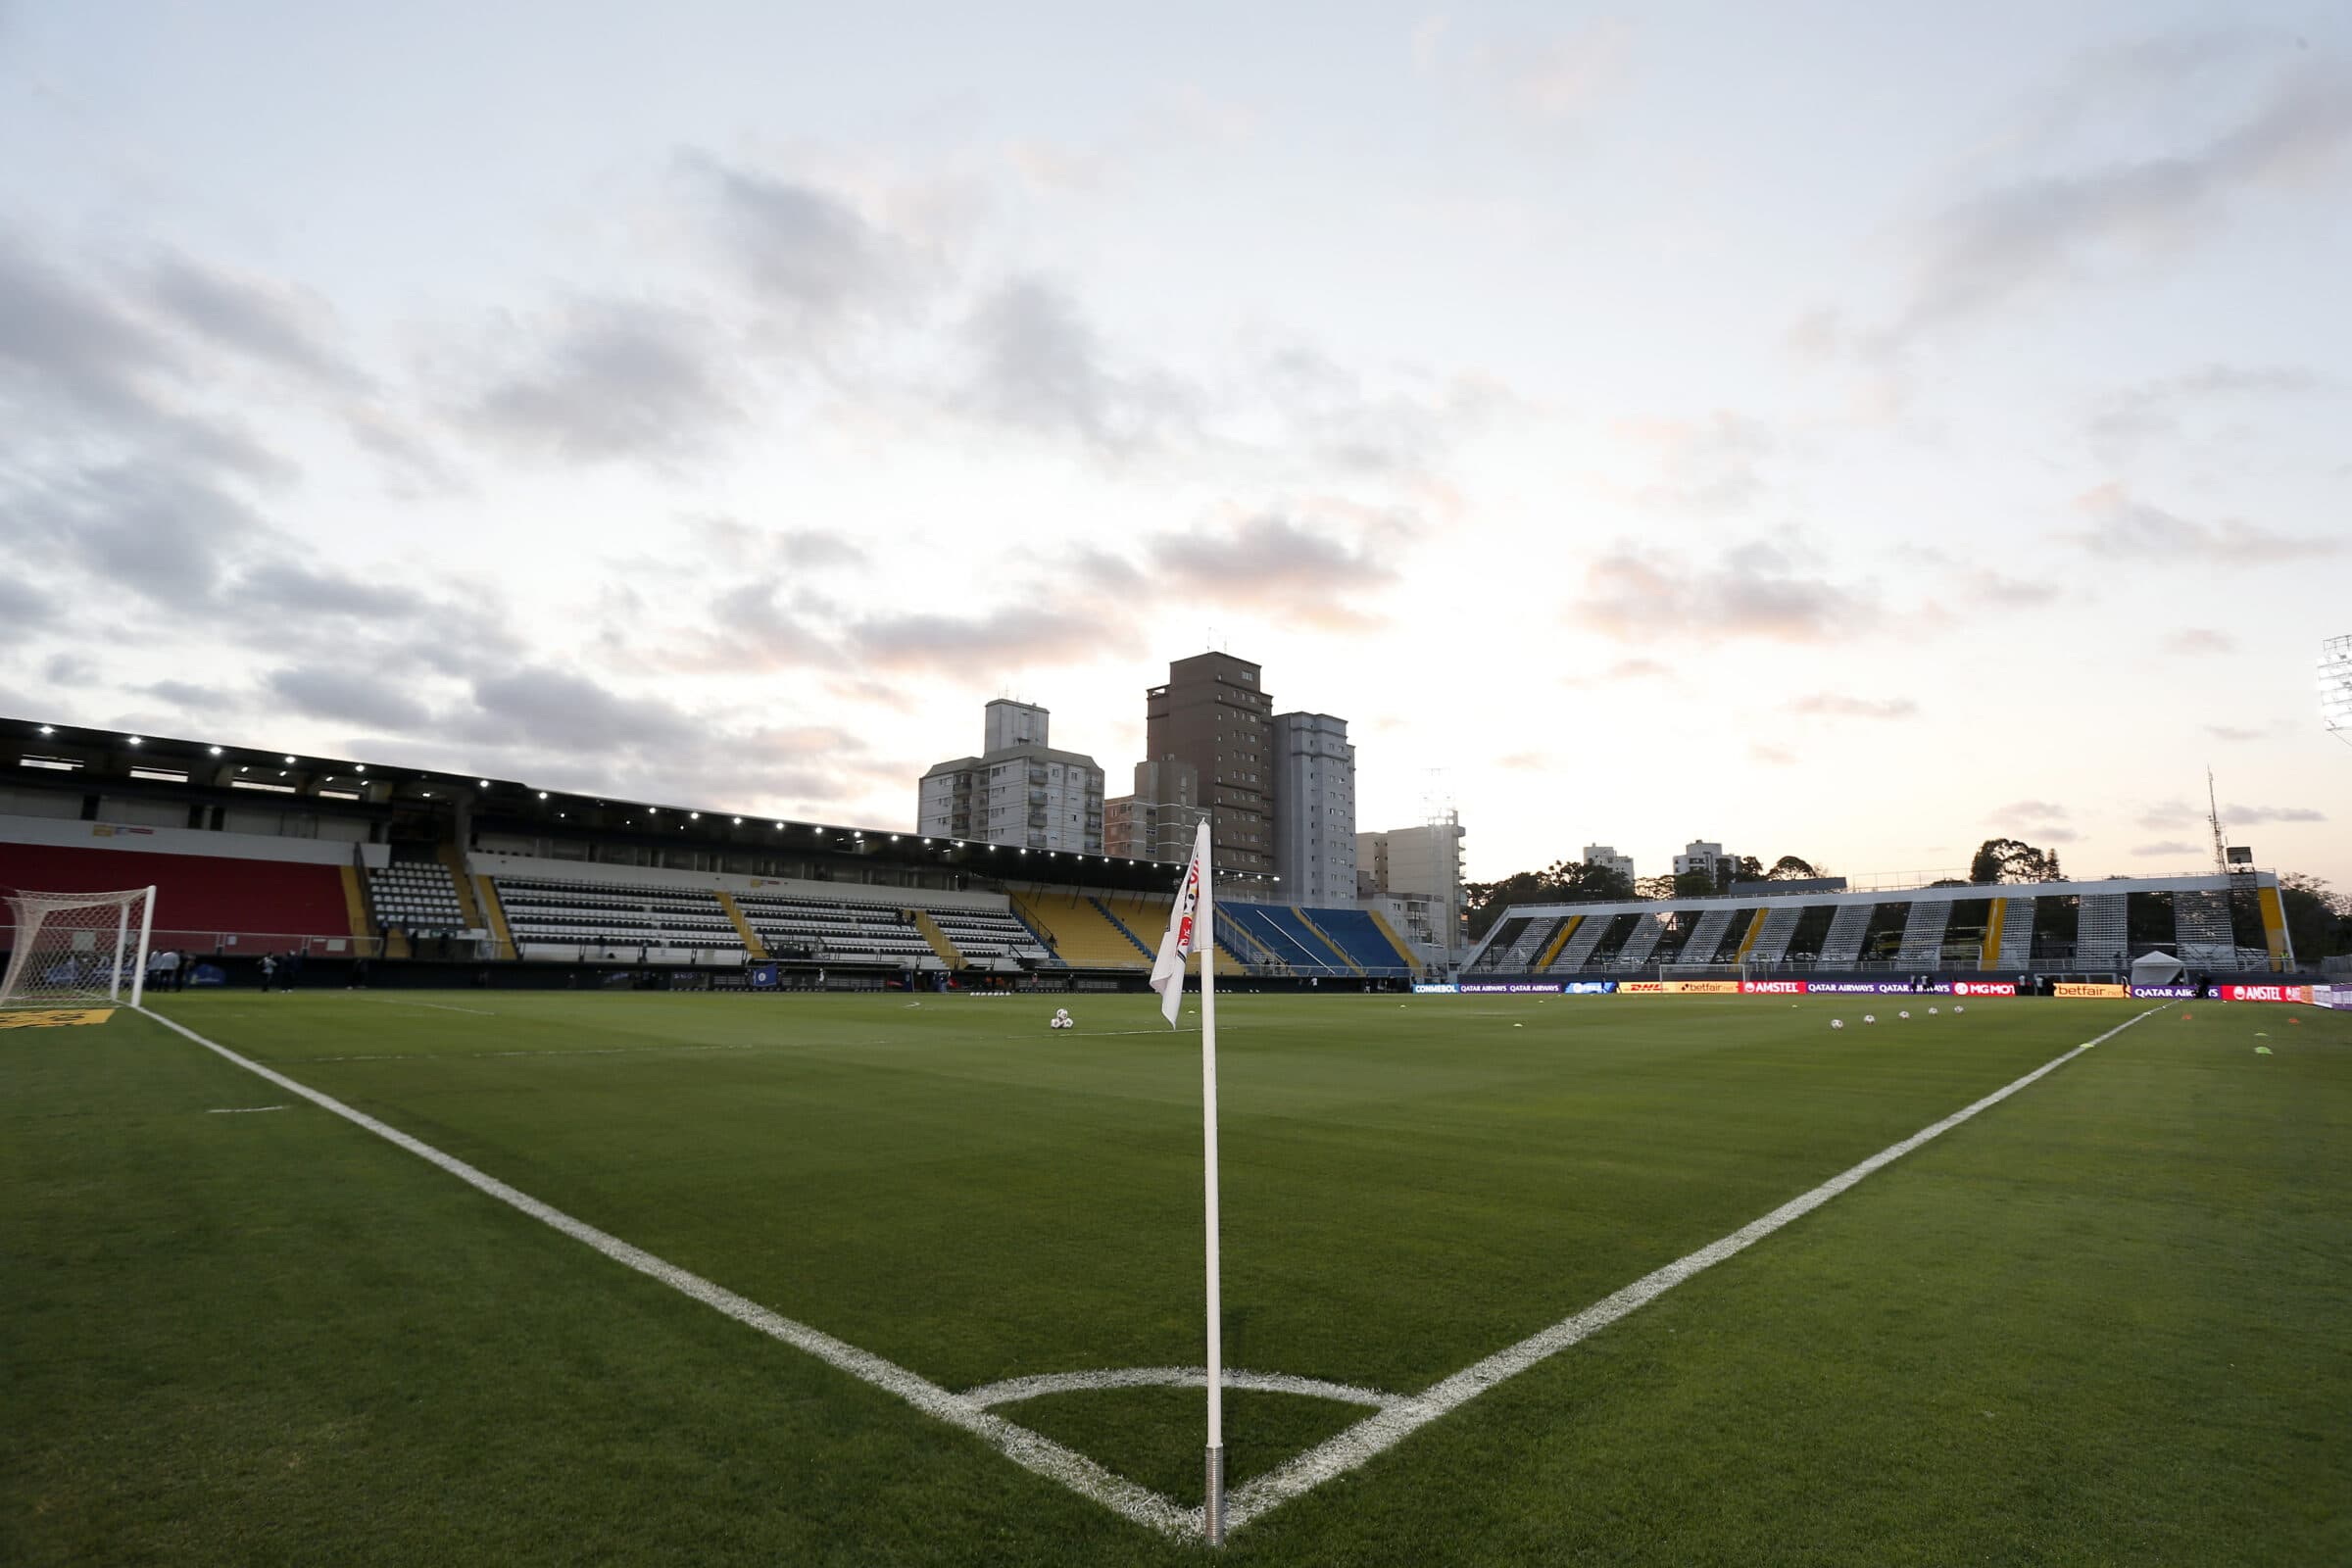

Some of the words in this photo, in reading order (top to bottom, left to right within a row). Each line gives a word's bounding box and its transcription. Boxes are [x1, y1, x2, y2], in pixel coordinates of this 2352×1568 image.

[1415, 984, 1457, 993] CONMEBOL
[1509, 984, 1530, 993] QATAR
[1755, 982, 1798, 993] AMSTEL
[1808, 984, 1837, 993] QATAR
[1838, 984, 1875, 993] AIRWAYS
[1879, 984, 1910, 993] QATAR
[1970, 984, 1989, 994] MG
[2134, 988, 2174, 998] QATAR
[2246, 987, 2281, 1000] AMSTEL
